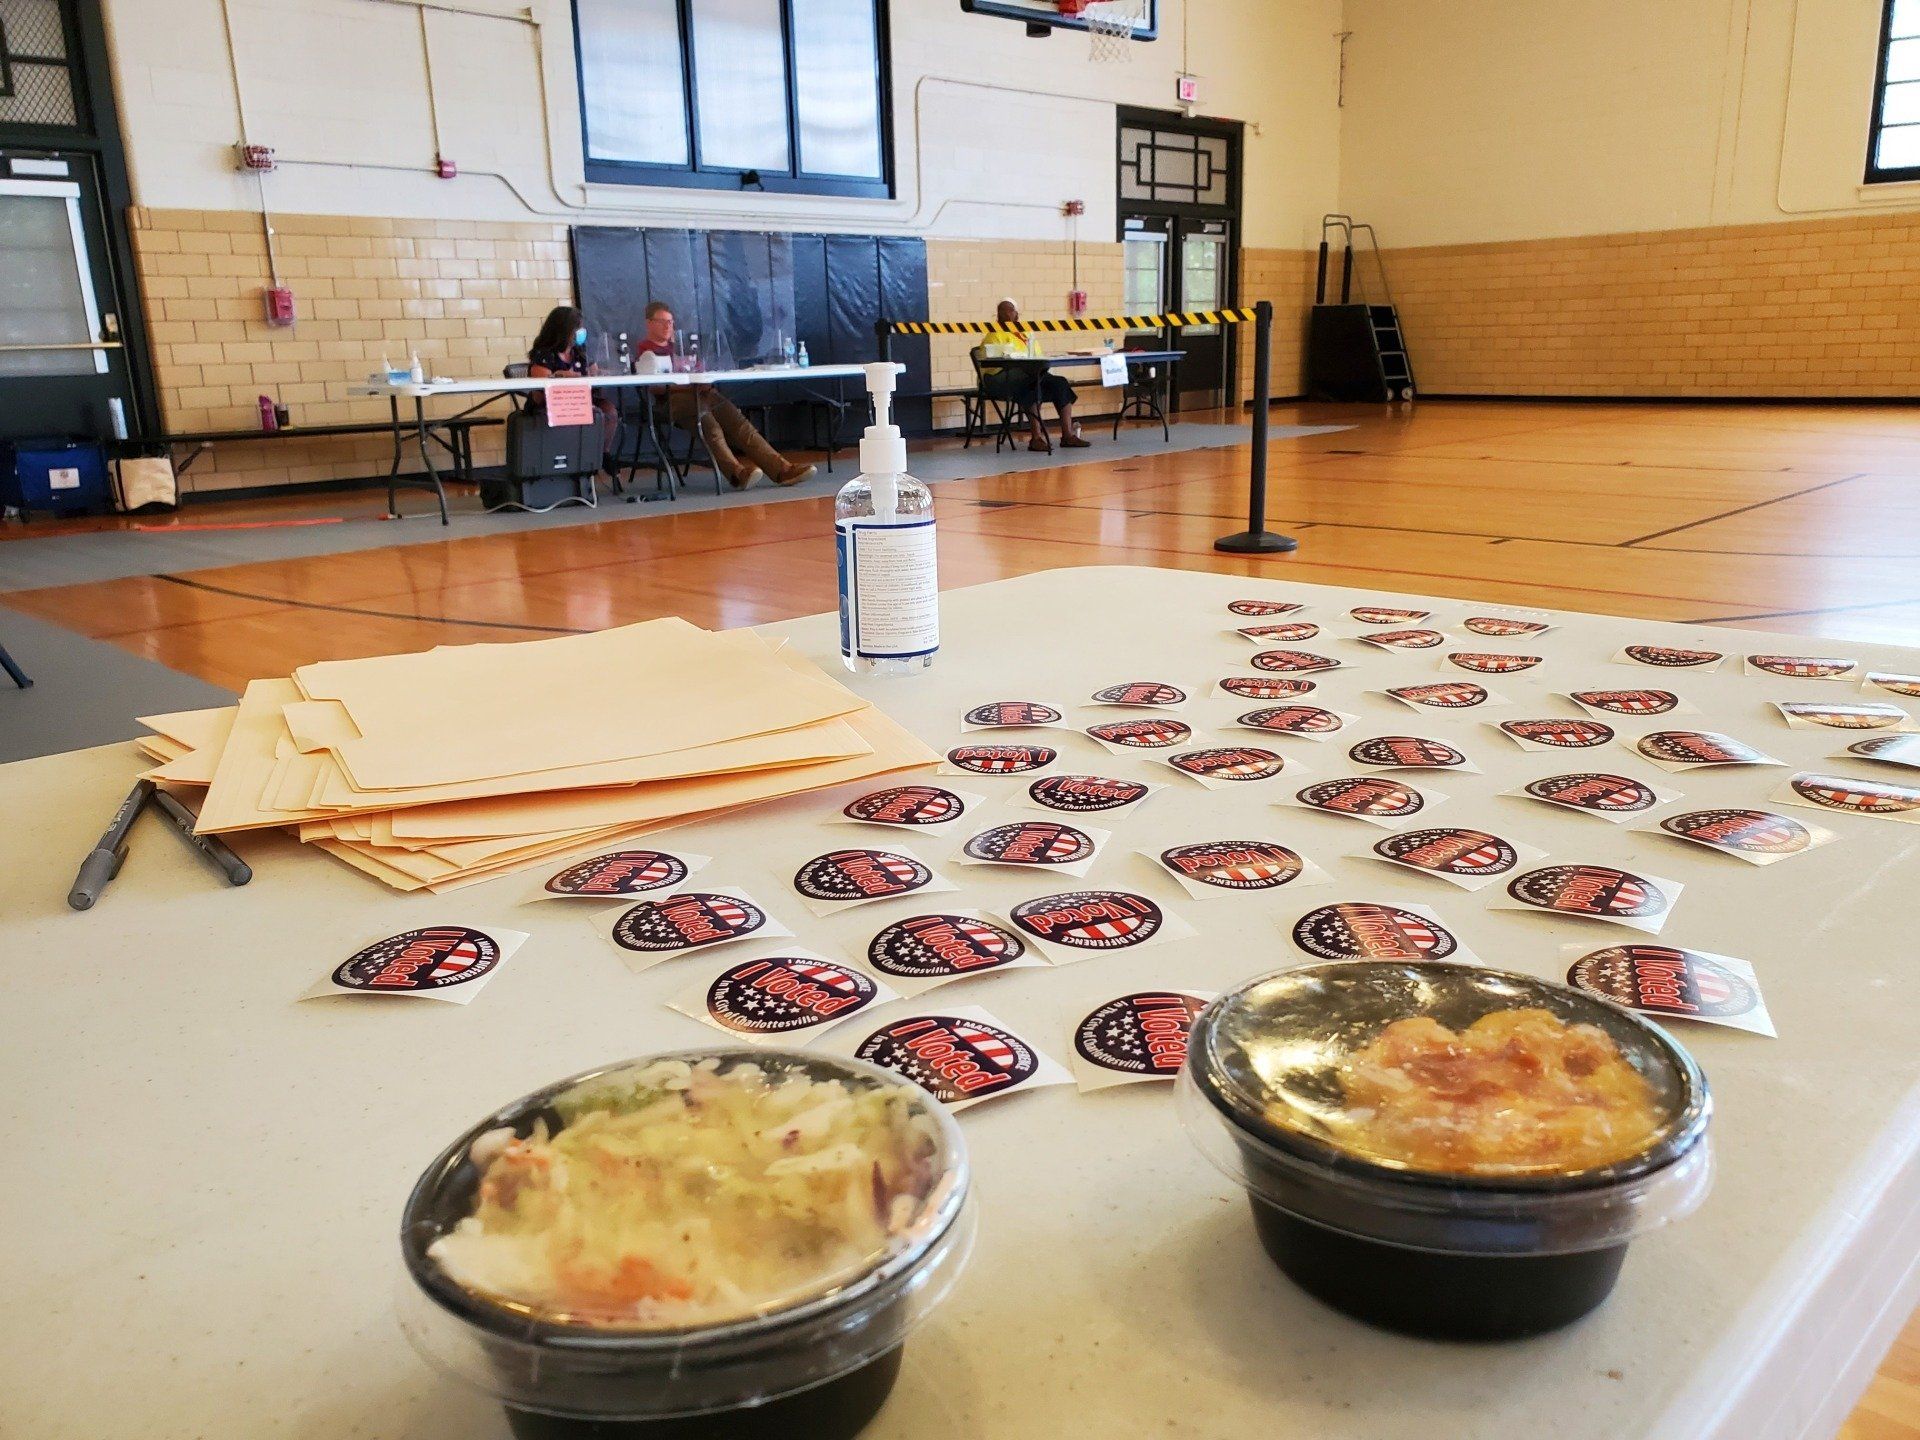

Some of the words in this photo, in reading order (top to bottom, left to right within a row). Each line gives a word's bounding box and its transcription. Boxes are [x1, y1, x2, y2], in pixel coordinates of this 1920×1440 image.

[1579, 691, 1658, 704] Voted
[1659, 691, 1672, 700] I
[1511, 723, 1593, 736] Voted
[1593, 723, 1607, 733] I
[955, 749, 1031, 762] Voted
[1038, 750, 1049, 762] I
[1179, 751, 1263, 772] Voted
[1250, 749, 1275, 760] I
[1038, 778, 1059, 789] I
[1057, 779, 1141, 800] Voted
[1456, 830, 1495, 842] I
[828, 851, 867, 861] I
[1268, 847, 1295, 863] I
[1401, 836, 1486, 868] Voted
[1172, 849, 1278, 874] Voted
[577, 859, 652, 892] Voted
[837, 856, 907, 895] Voted
[1579, 867, 1623, 877] I
[1204, 875, 1268, 888] DIFFERENCE
[654, 895, 696, 907] I
[1553, 875, 1623, 913] Voted
[1122, 897, 1152, 913] I
[661, 901, 735, 943] Voted
[902, 916, 944, 929] I
[1023, 901, 1136, 935] Voted
[624, 935, 685, 949] Charlottesville
[1061, 935, 1129, 947] DIFFERENCE
[1346, 913, 1423, 959] Voted
[914, 923, 1000, 970] Voted
[1632, 948, 1684, 960] I
[368, 939, 459, 987] Voted
[731, 961, 773, 980] I
[795, 959, 827, 969] MADE
[882, 957, 950, 974] Charlottesville
[436, 959, 491, 986] DIFFERENCE
[714, 986, 730, 1000] The
[751, 966, 862, 1016] Voted
[1634, 960, 1700, 1012] Voted
[716, 999, 729, 1014] City
[1096, 1006, 1118, 1017] The
[734, 1013, 819, 1029] Charlottesville
[888, 1019, 938, 1038] I
[904, 1028, 1012, 1093] Voted
[1083, 1038, 1146, 1070] Charlottesville
